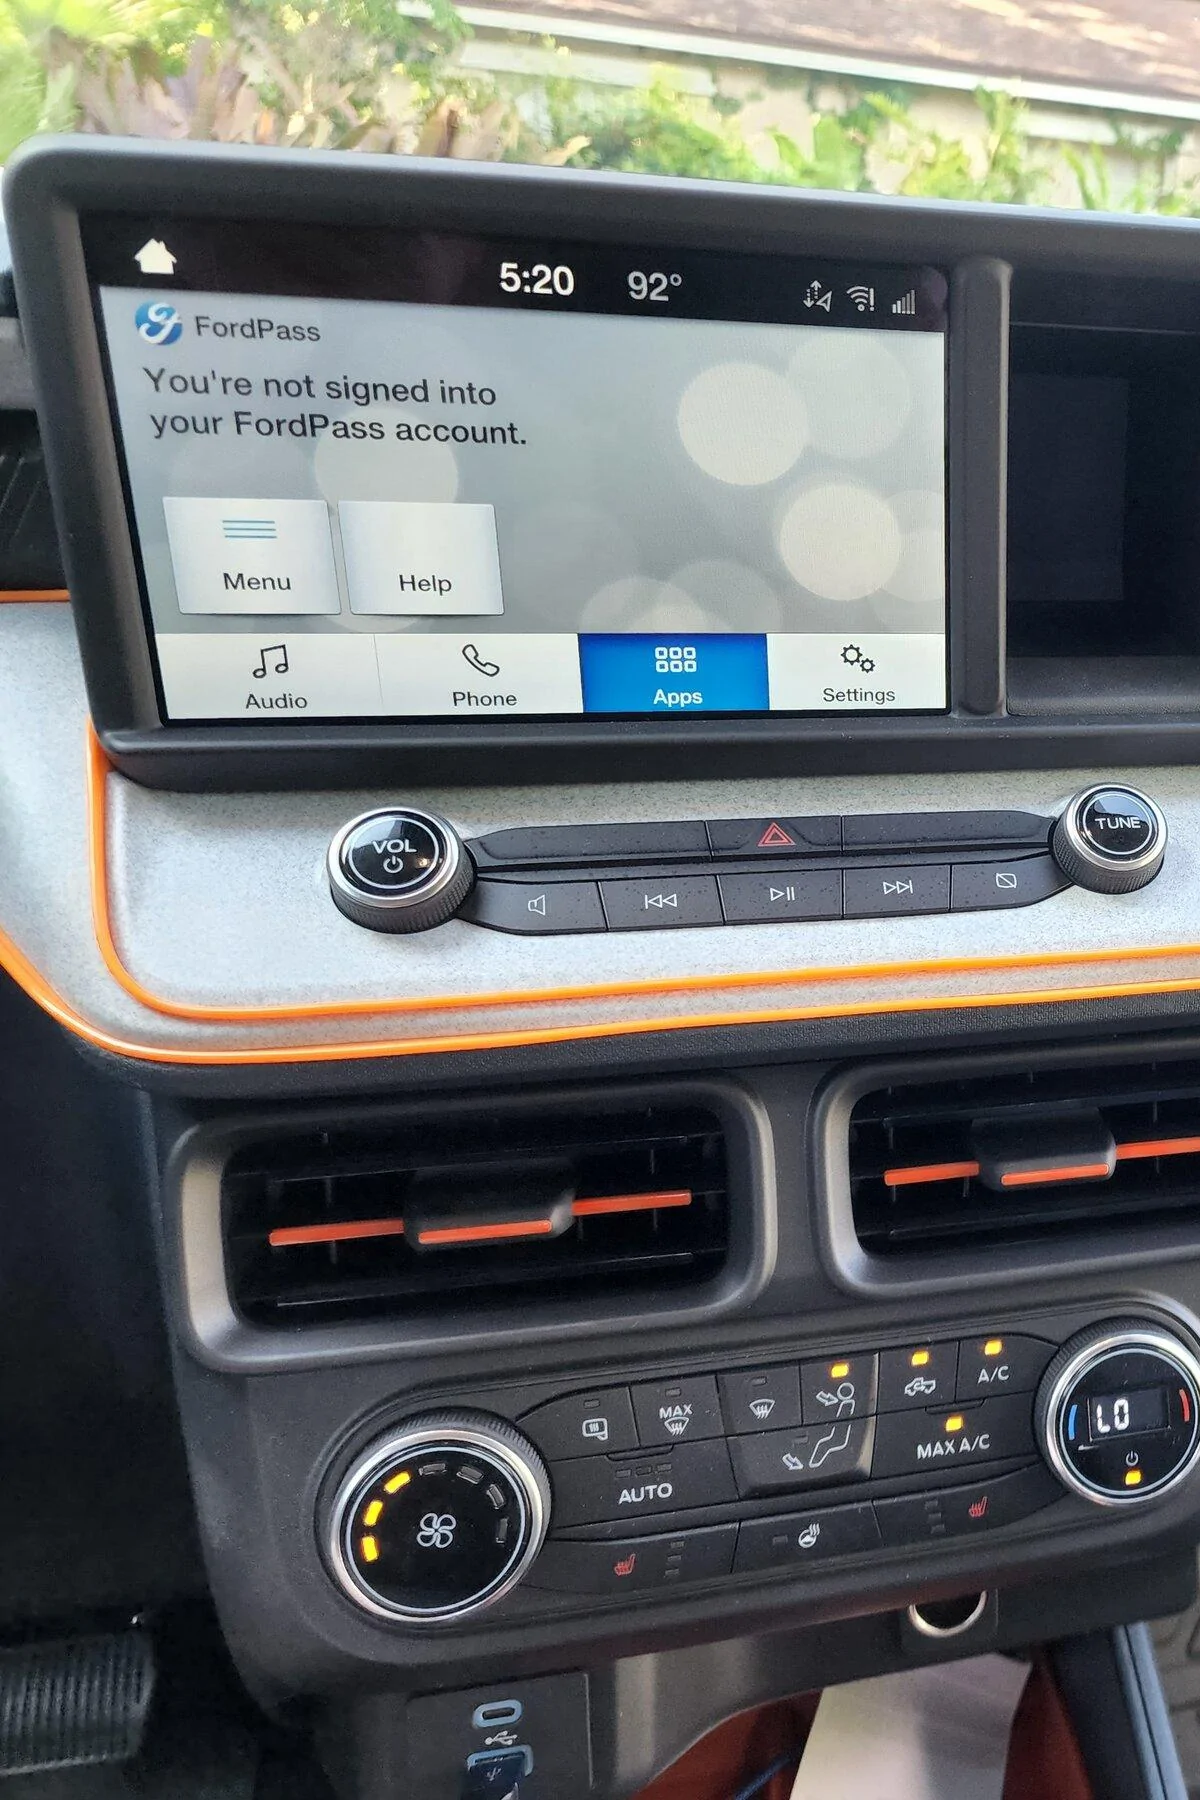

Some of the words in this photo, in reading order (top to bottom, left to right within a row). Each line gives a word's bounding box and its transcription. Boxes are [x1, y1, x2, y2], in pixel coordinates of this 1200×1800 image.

[500, 262, 574, 296] 5:20
[195, 315, 321, 342] FordPass
[143, 367, 252, 396] You're
[264, 375, 315, 399] not
[326, 375, 429, 405] signed
[439, 379, 496, 405] into
[150, 415, 222, 439] your
[234, 411, 385, 441] FordPass
[396, 423, 527, 445] account.
[223, 572, 292, 591] Menu
[399, 574, 452, 596] Help
[245, 693, 308, 710] Audio
[452, 691, 517, 707] Phone
[653, 688, 703, 706] Apps
[823, 687, 896, 705] Settings
[1095, 816, 1141, 830] TUNE
[372, 839, 417, 854] VOL
[977, 1365, 1009, 1384] A/C
[659, 1403, 692, 1419] MAX
[916, 1439, 955, 1460] MAX
[958, 1434, 991, 1453] A/C
[618, 1482, 673, 1505] AUTO
